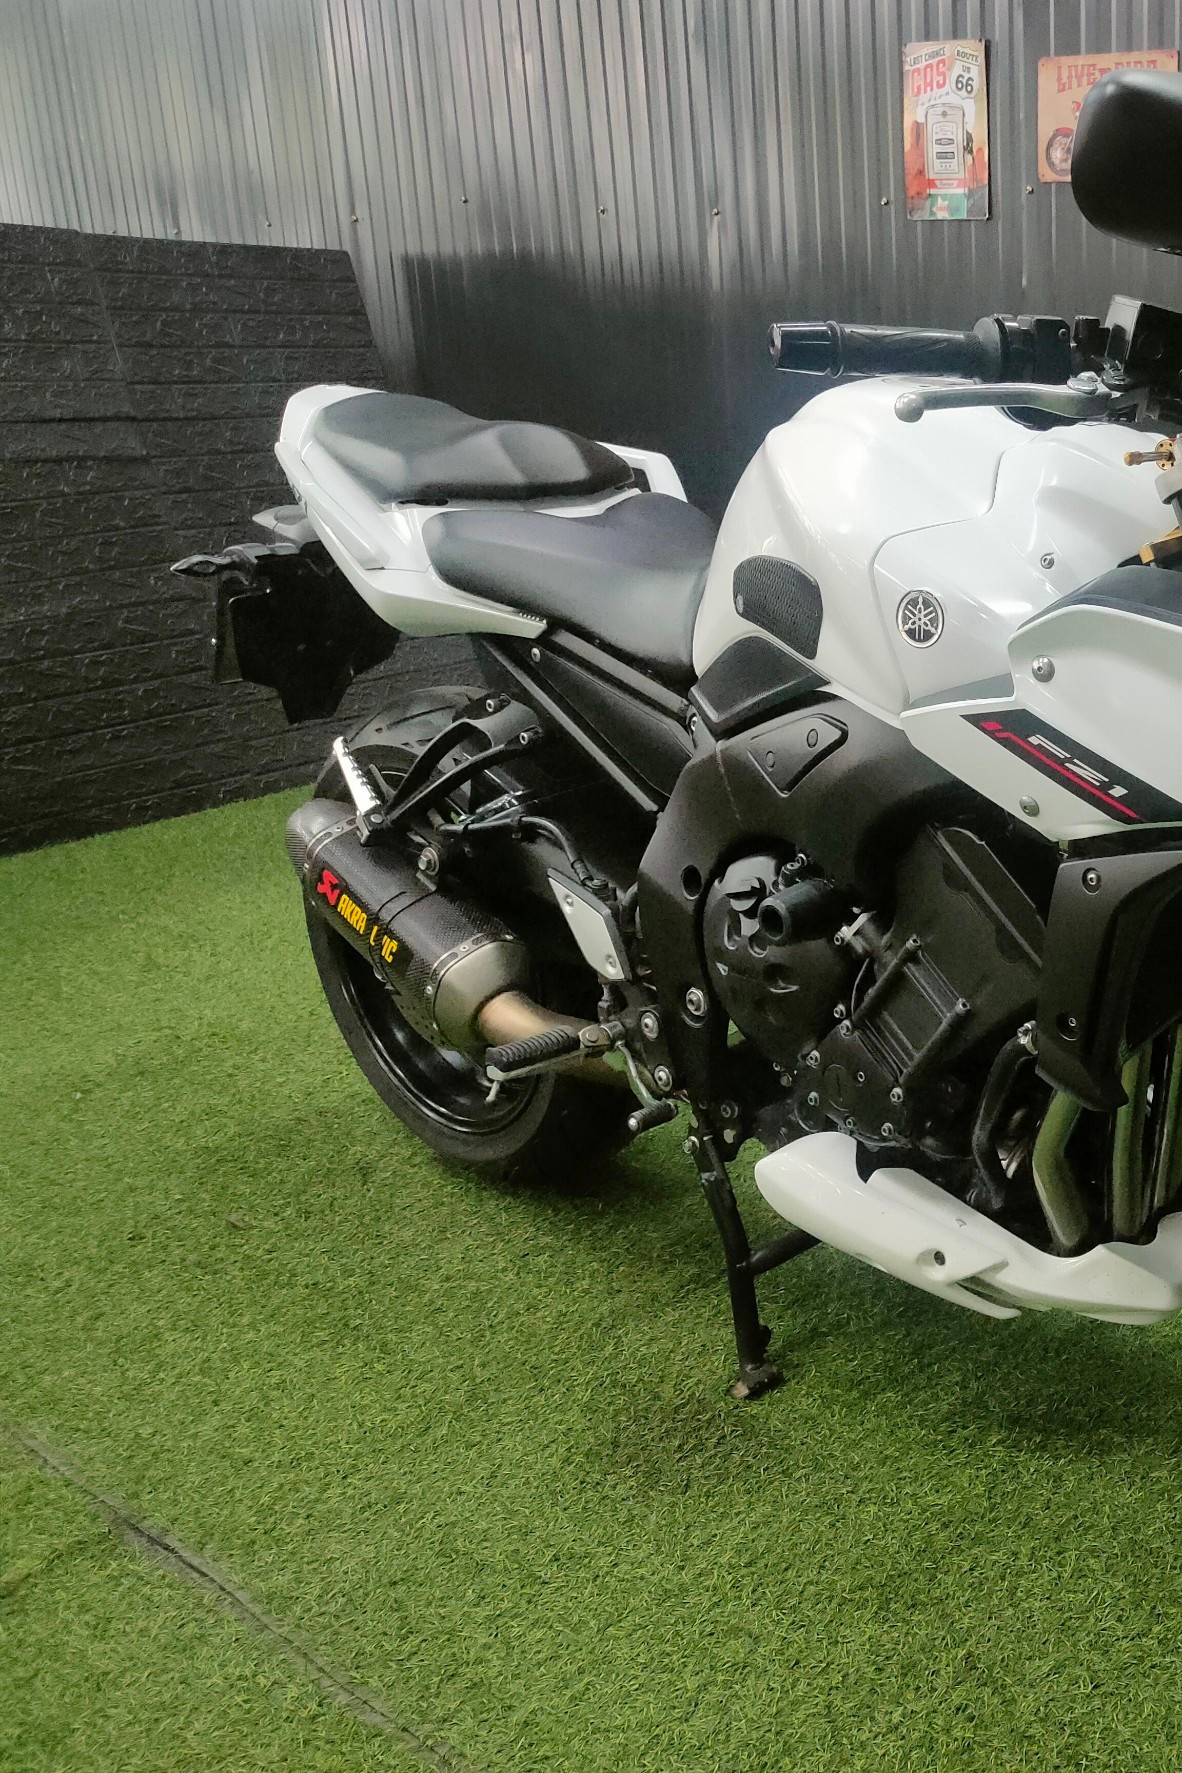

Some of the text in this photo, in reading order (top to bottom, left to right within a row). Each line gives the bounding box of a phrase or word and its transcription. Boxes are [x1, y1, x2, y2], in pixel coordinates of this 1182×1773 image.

[924, 47, 946, 62] CHANCE
[956, 49, 979, 64] ROUTE
[911, 58, 947, 98] GAS
[961, 65, 972, 75] US
[1056, 63, 1098, 94] LIVE
[955, 74, 975, 95] 66
[1027, 734, 1129, 798] FZ1
